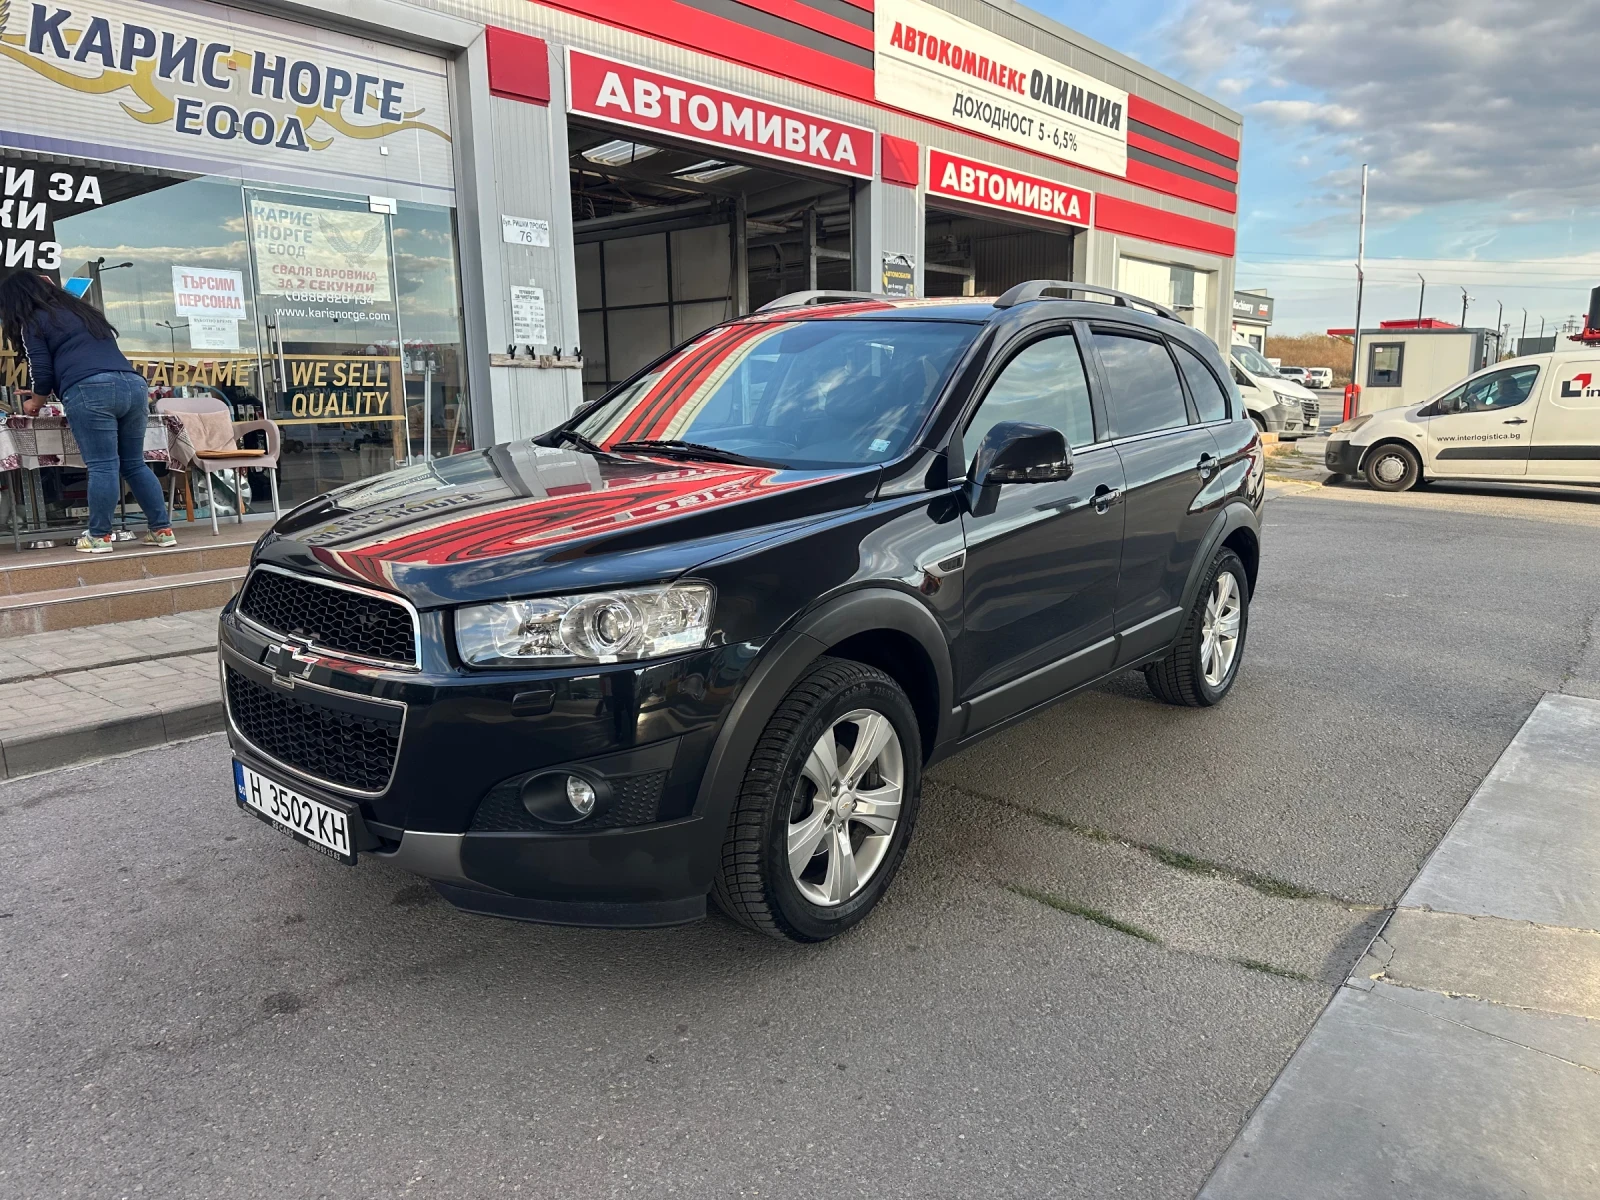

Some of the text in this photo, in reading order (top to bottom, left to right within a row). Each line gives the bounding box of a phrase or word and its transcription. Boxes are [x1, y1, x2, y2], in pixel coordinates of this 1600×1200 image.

[28, 3, 405, 121] КАРИС НОРГЕ
[890, 21, 1122, 132] АВТОКОМПЛЕКС ОЛИМПИЯ
[176, 98, 310, 152] ЕООД
[594, 70, 857, 166] АВТОМИВКА
[953, 92, 1034, 137] ДОХОДНОСТ
[1038, 122, 1045, 141] 5
[1053, 127, 1078, 152] 6,5%
[48, 172, 103, 205] ЗА
[940, 162, 1081, 219] АВТОМИВКА
[253, 206, 313, 227] КАРИС
[257, 224, 313, 244] НОРГЕ
[520, 230, 533, 243] 76
[268, 242, 306, 259] ЕООД
[272, 264, 378, 281] СВАЛЯ ВАРОВИКА
[181, 275, 236, 292] ТЪРСИМ
[277, 278, 375, 294] ЗА 2 СЕКУНДИ
[178, 293, 242, 309] ПЕРСОНАЛ
[291, 290, 324, 304] 0886
[326, 292, 350, 304] 820
[275, 307, 391, 322] www.karisnorge.com
[292, 361, 388, 387] WE SELL
[292, 391, 389, 418] QUALITY
[1436, 432, 1521, 442] www.interlogistica.bg
[249, 773, 263, 807] H
[269, 784, 315, 836] 3502
